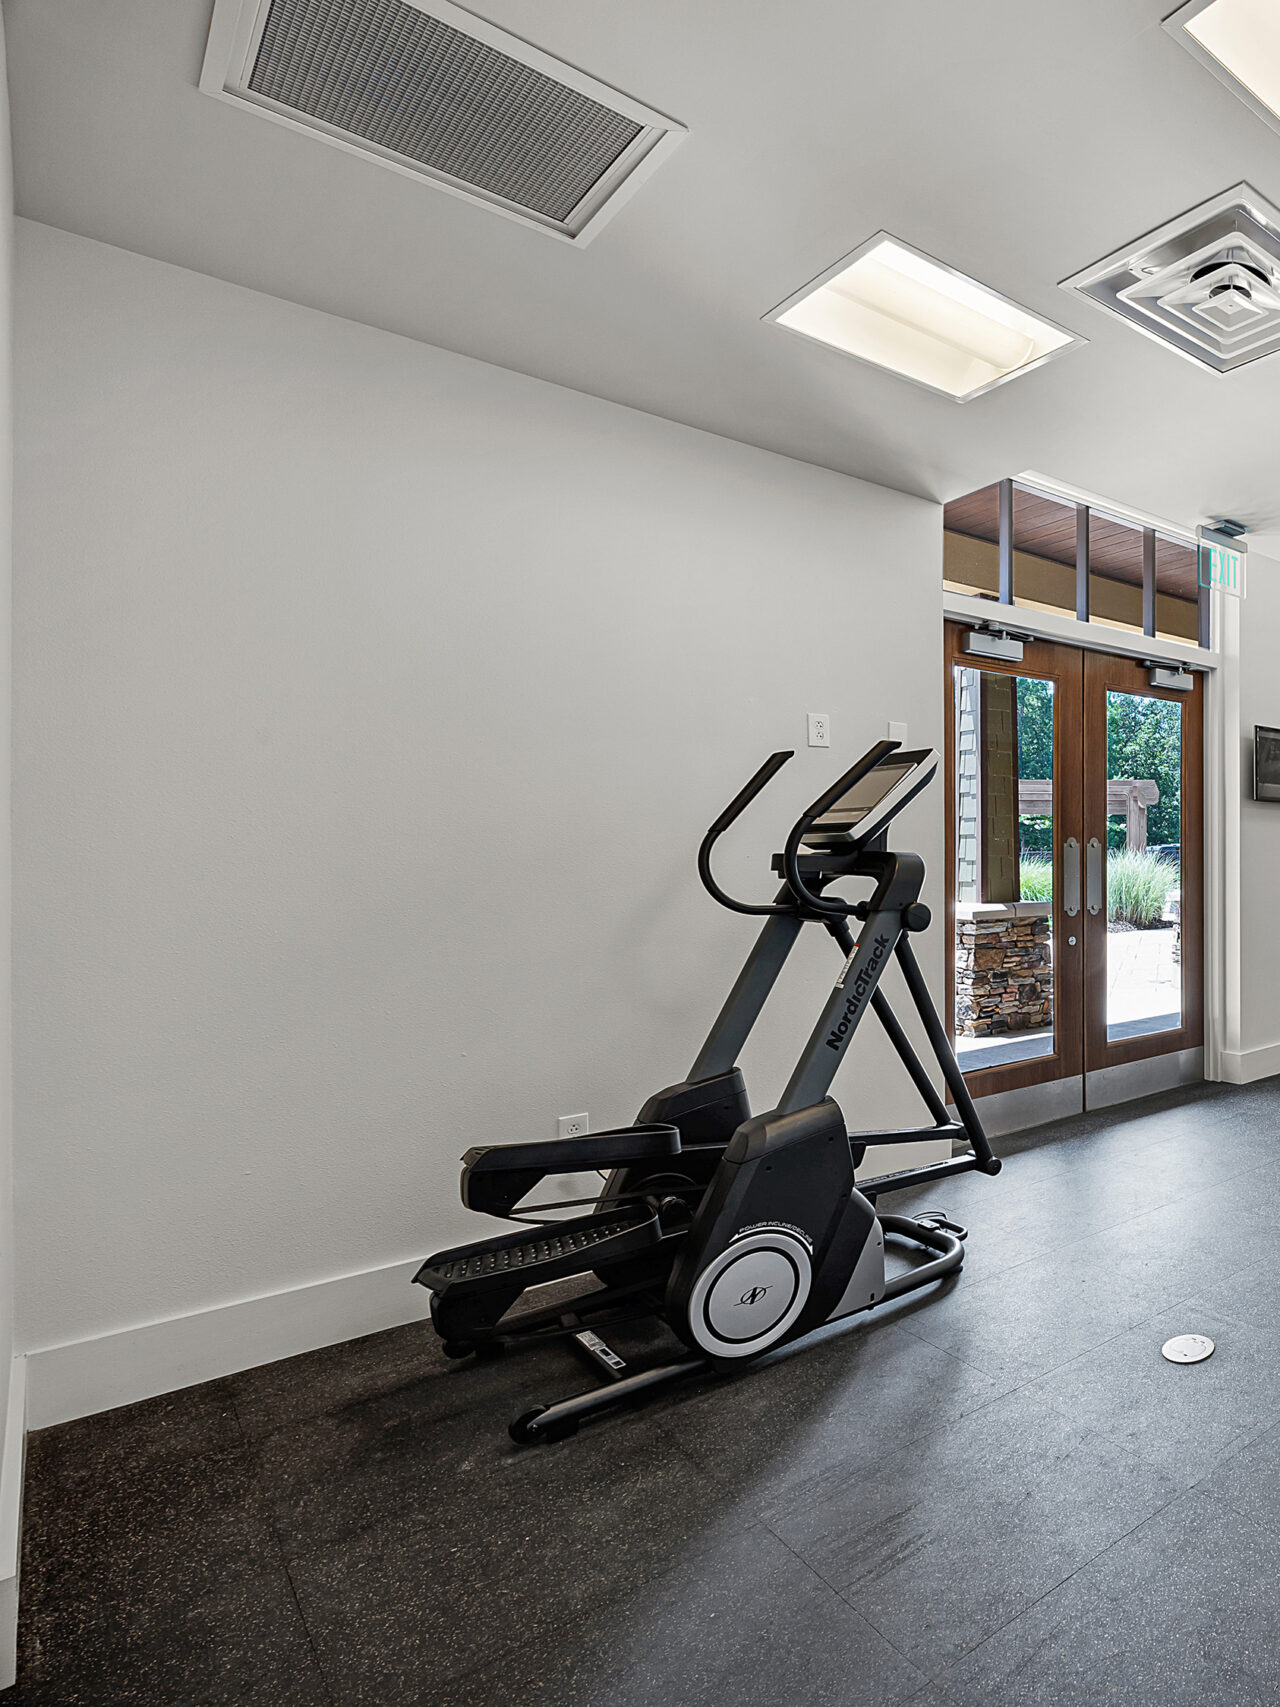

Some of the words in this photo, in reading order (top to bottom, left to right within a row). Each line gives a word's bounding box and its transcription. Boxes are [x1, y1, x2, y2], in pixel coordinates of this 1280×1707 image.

[1209, 547, 1238, 589] EXIT
[825, 933, 890, 1052] NordicTrack
[739, 1221, 767, 1233] POWER
